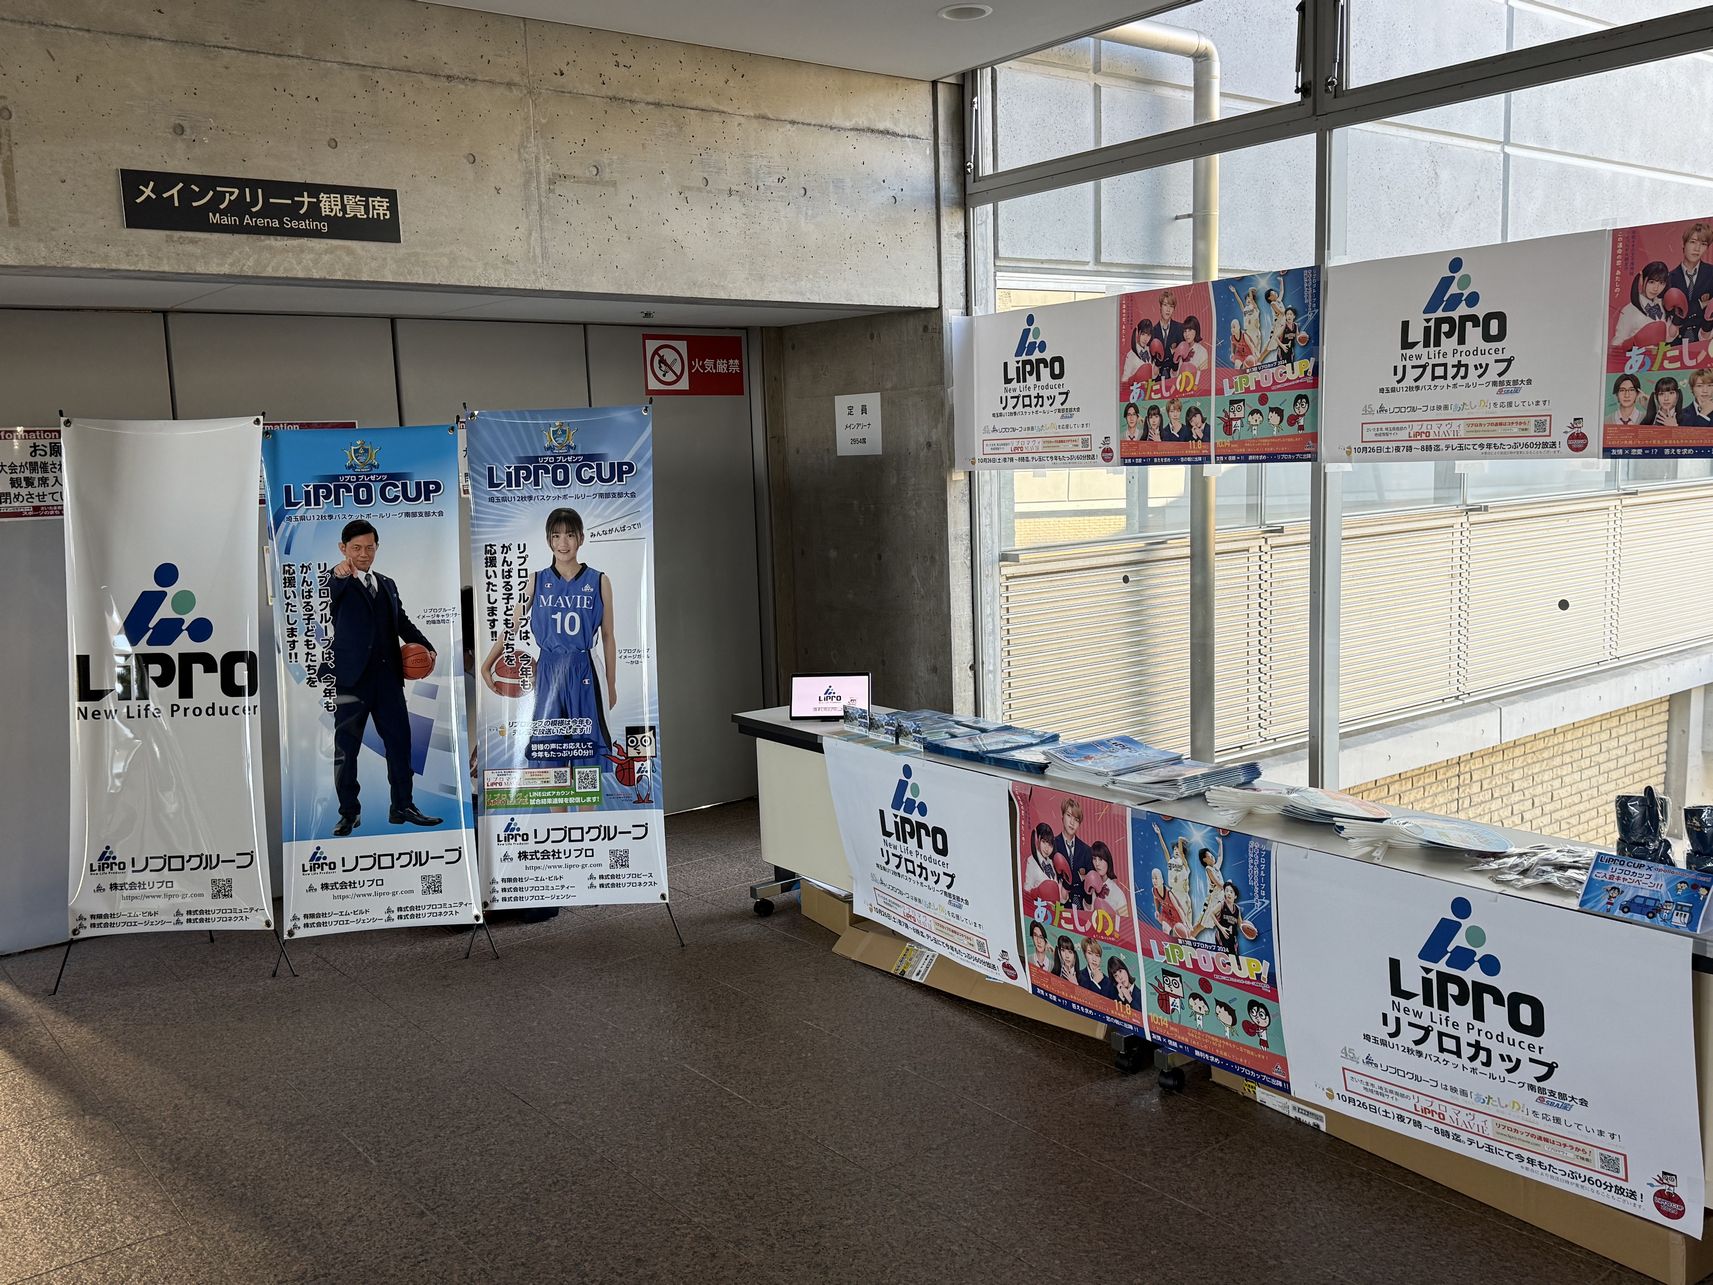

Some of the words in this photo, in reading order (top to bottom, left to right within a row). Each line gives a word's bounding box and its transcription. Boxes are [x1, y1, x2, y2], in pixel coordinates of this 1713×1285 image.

[135, 181, 390, 220] メインアリーナ観覧席
[209, 212, 239, 226] Main
[243, 214, 280, 228] Arena
[283, 216, 328, 232] Seating
[1400, 351, 1423, 362] New
[1427, 349, 1448, 360] Life
[1452, 346, 1506, 358] Producer
[1625, 338, 1713, 374] あたし
[691, 358, 741, 373] 火気厳禁
[1393, 356, 1515, 384] リプロカップ
[1003, 386, 1018, 394] New
[1019, 384, 1031, 392] Life
[1033, 382, 1065, 391] Producer
[1000, 390, 1070, 410] リプロカップ
[575, 461, 637, 486] CUP
[379, 479, 444, 505] CUP
[500, 543, 516, 666] がんばる子どもたちを
[539, 594, 594, 610] MAVIE
[299, 563, 318, 687] がんばる子どもたちを
[551, 611, 581, 636] 10
[76, 706, 117, 720] New
[126, 703, 162, 718] Life
[170, 702, 258, 718] Producer
[534, 823, 648, 844] リプログループ
[131, 851, 254, 873] リプログループ
[341, 846, 462, 873] リプログループ
[518, 848, 595, 862] 株式会社リプロ
[883, 838, 898, 851] New
[899, 843, 914, 857] Life
[915, 849, 950, 869] Producer
[1626, 859, 1646, 869] CUP
[880, 847, 956, 890] リプロカップ
[1610, 866, 1652, 879] リプロカップ
[109, 880, 174, 892] 株式会社リプロ
[320, 879, 384, 891] 株式会社リプロ
[332, 888, 415, 900] https://www.lipro-gr.com
[1033, 896, 1121, 939] あたしの!
[1391, 1000, 1423, 1019] New
[1429, 1011, 1460, 1030] Life
[1467, 1022, 1544, 1055] Producer
[1381, 1012, 1559, 1083] リプロカップ
[1363, 1033, 1589, 1107] 埼玉県U12秋季バスケットボールリーグ南部支部大会
[1449, 1115, 1490, 1136] MAVIE
